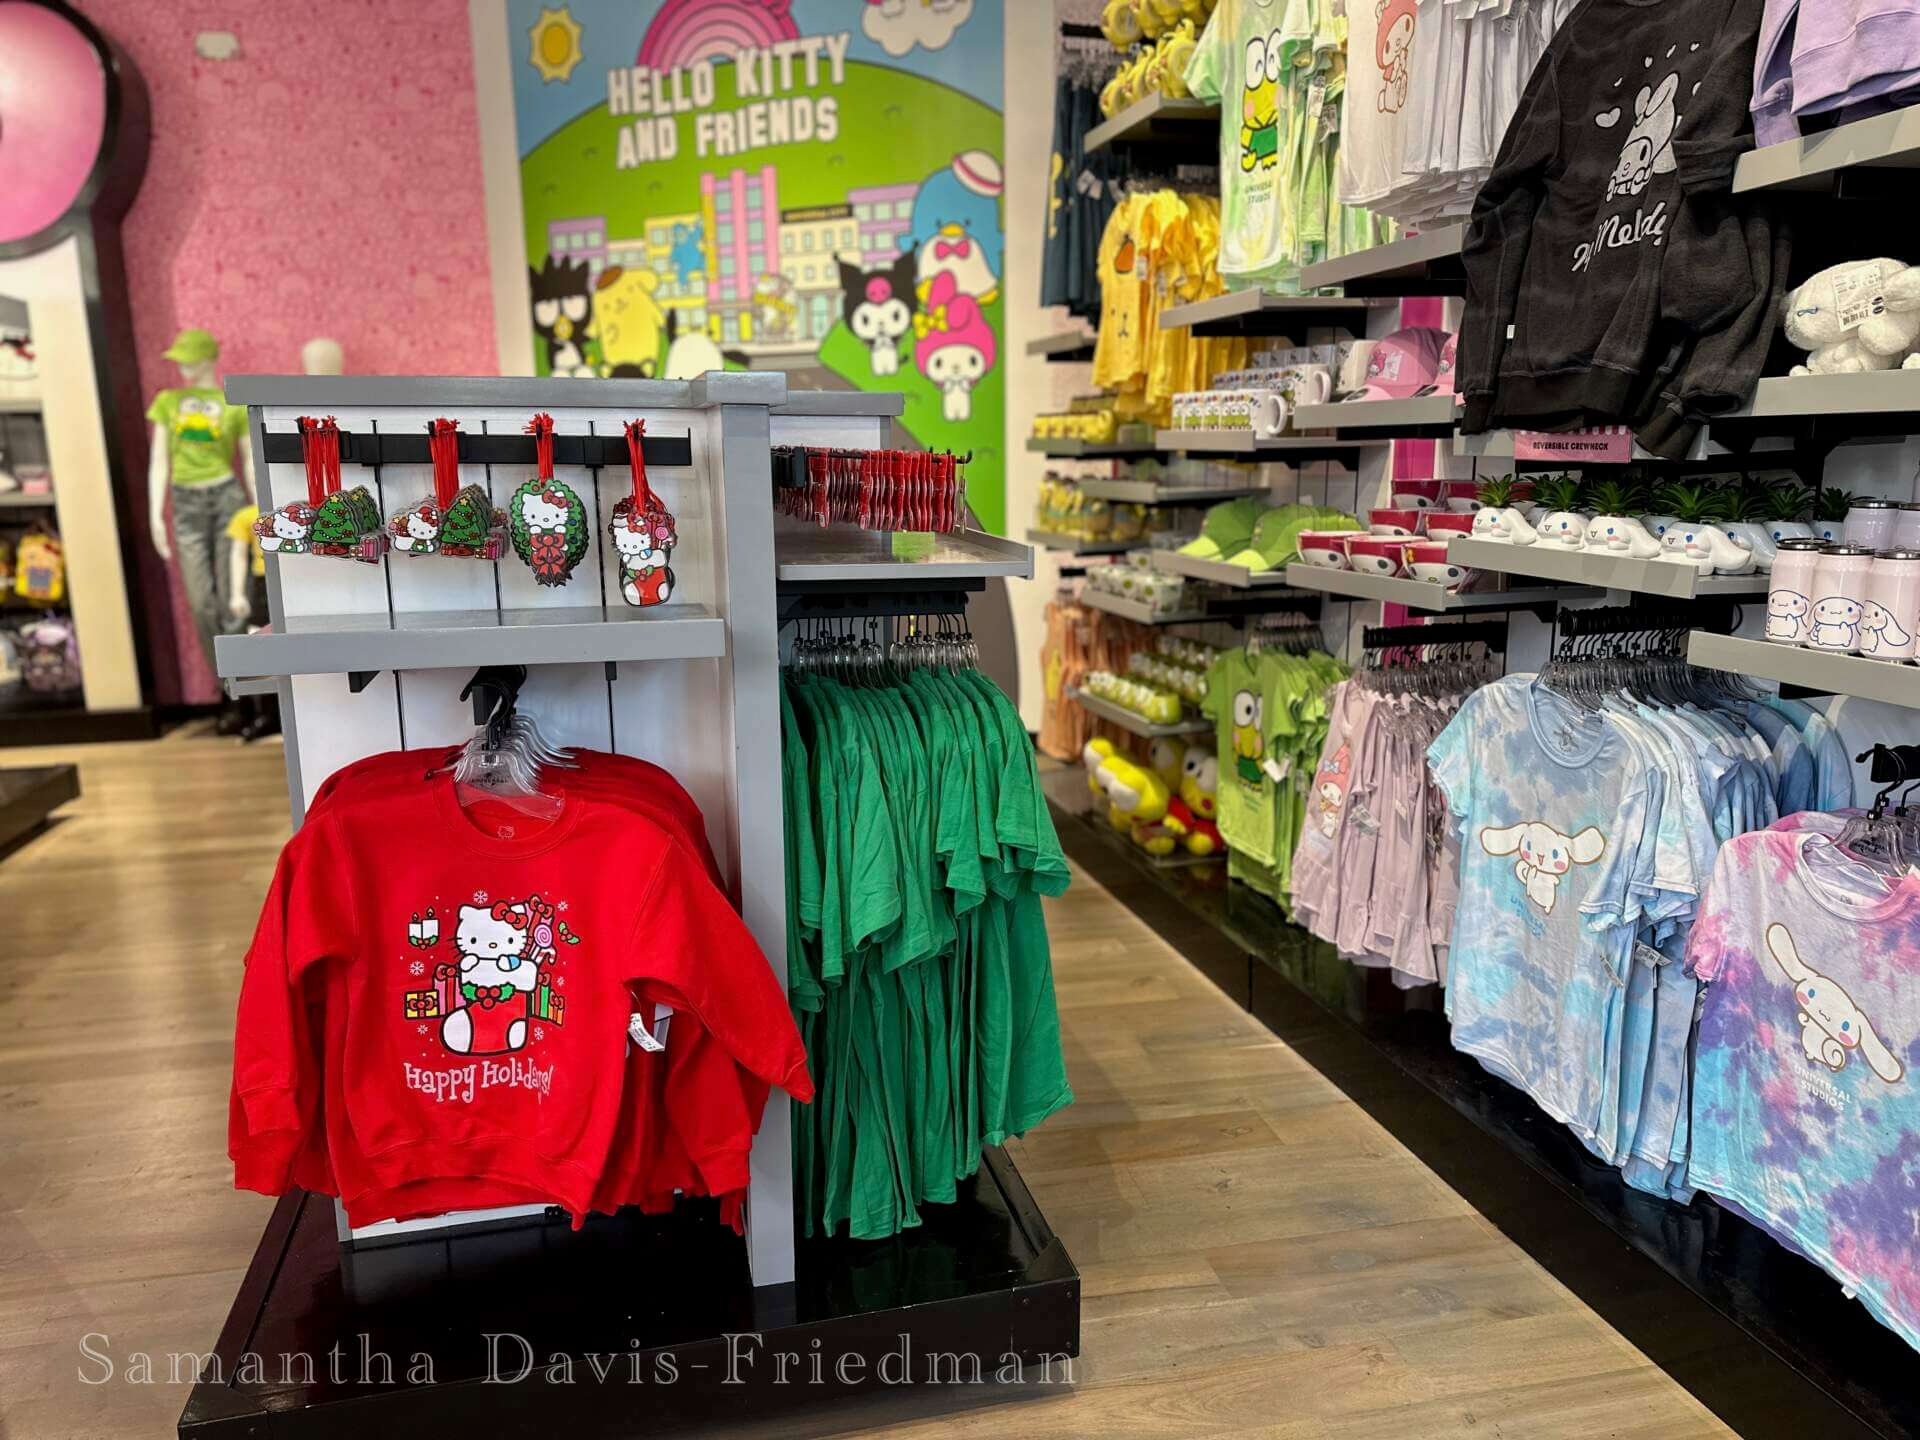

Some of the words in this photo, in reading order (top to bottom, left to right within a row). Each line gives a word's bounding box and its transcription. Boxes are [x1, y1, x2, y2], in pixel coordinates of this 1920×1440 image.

[608, 59, 715, 115] HELLO
[736, 32, 849, 97] KITTY
[617, 115, 678, 170] AND
[696, 96, 839, 157] FRIENDS
[1533, 441, 1569, 450] REVERSIBLE
[1570, 441, 1609, 451] CREWNECK
[403, 1062, 477, 1103] Happy
[1794, 1062, 1852, 1104] UNIVERSAL
[1801, 1079, 1845, 1112] STUDIOS
